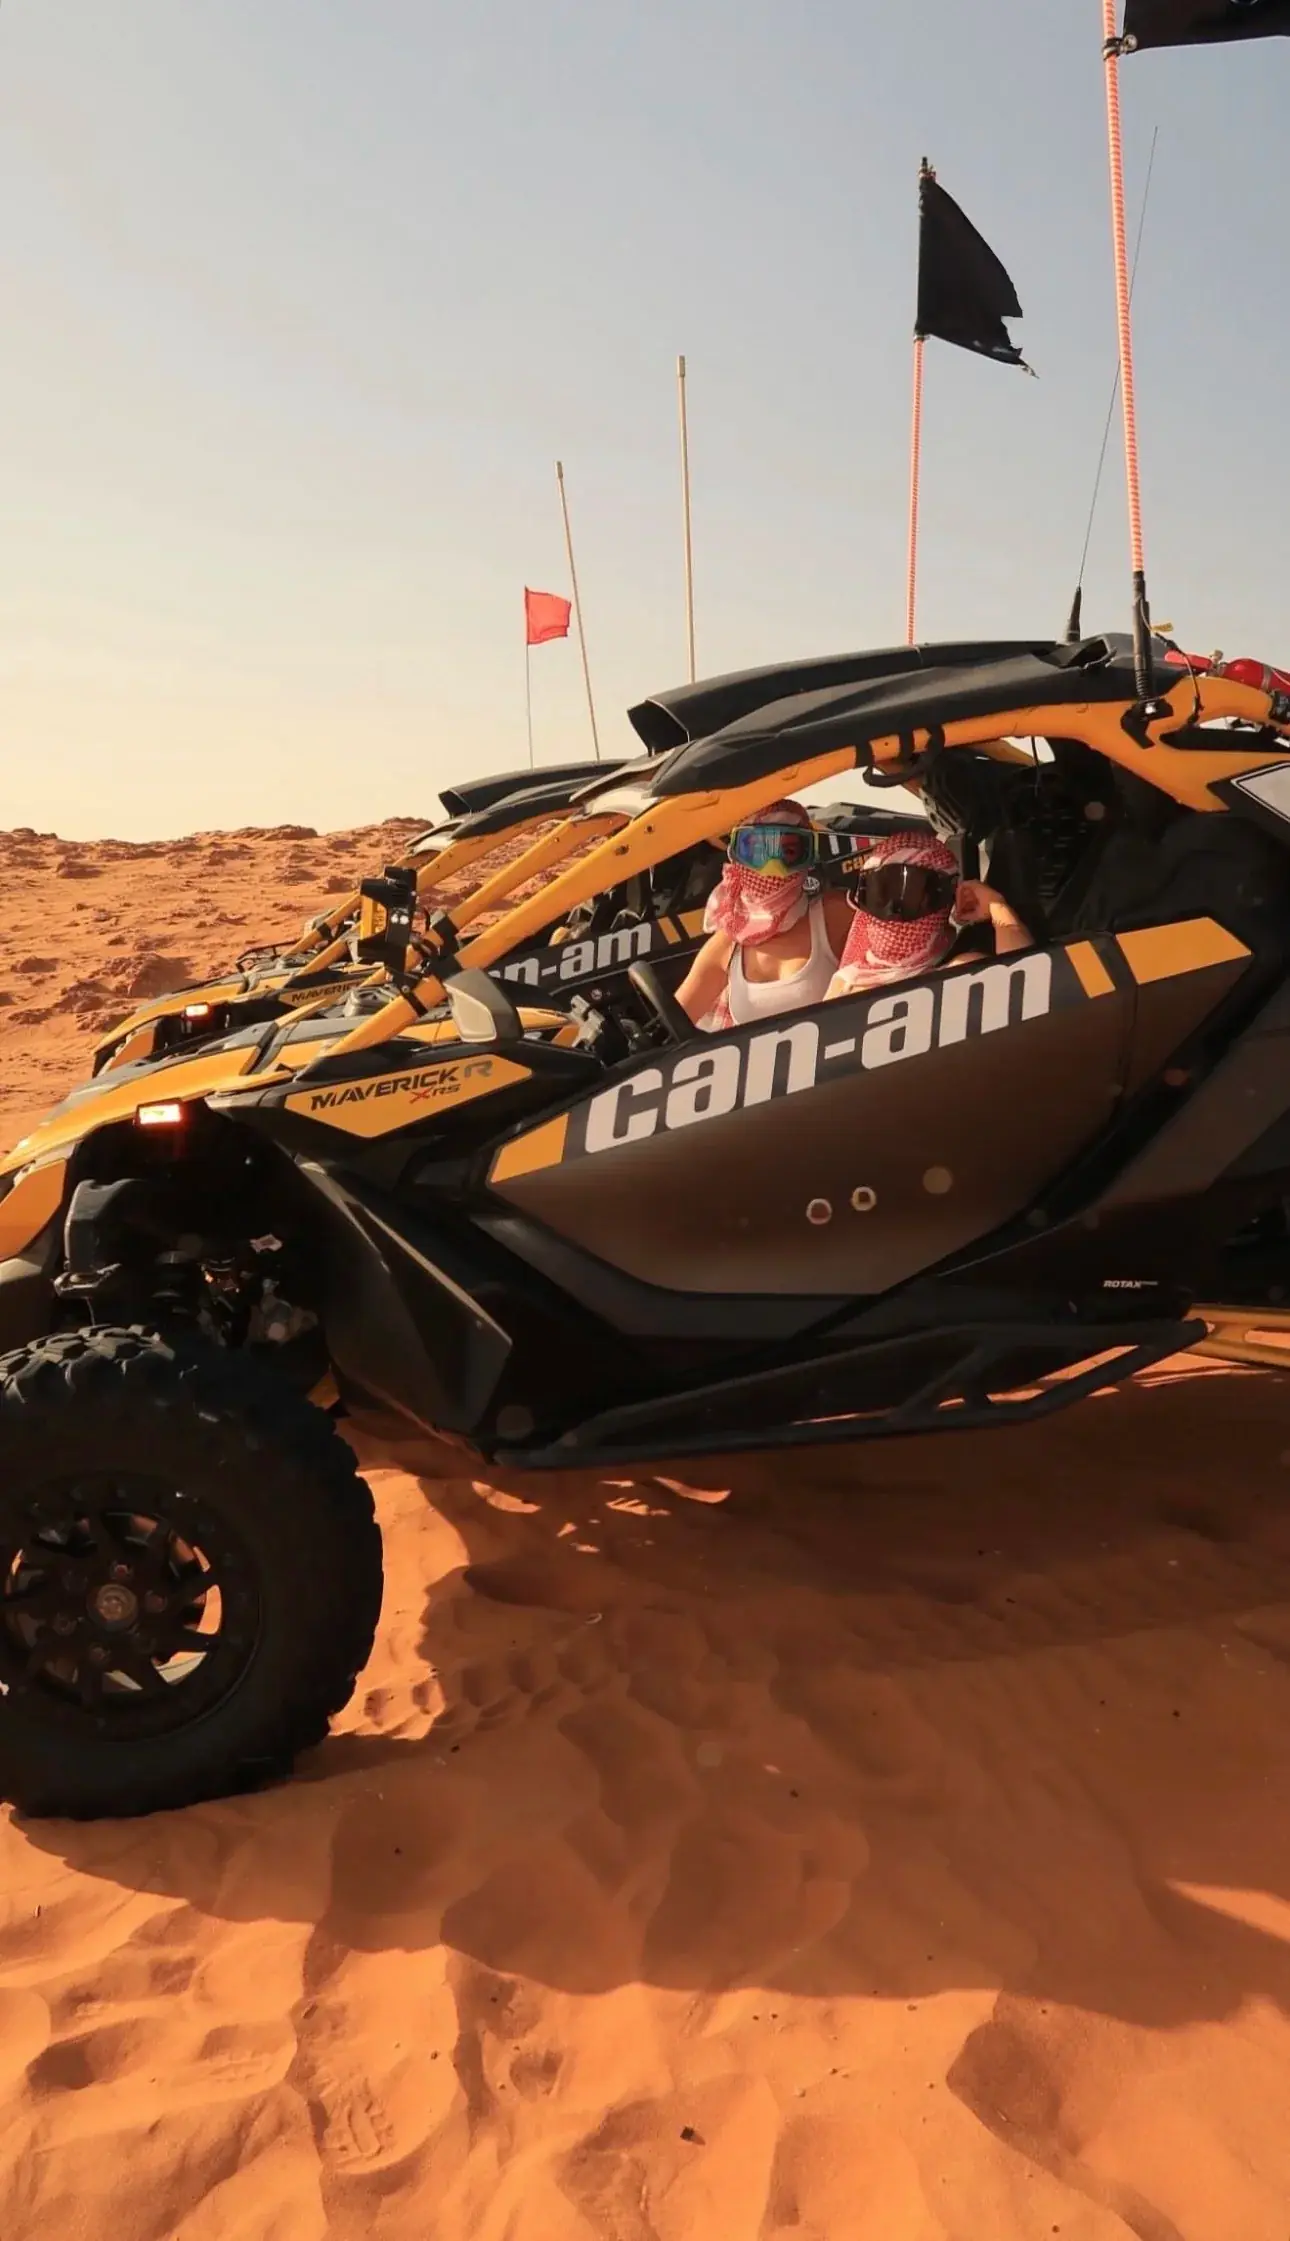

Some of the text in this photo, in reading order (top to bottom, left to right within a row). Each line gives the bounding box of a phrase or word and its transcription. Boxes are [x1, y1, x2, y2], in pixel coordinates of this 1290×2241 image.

[488, 922, 652, 986] n-am
[585, 952, 1052, 1154] can-am
[310, 1060, 494, 1112] MAVERICK R
[1103, 1279, 1142, 1289] ROTAX
